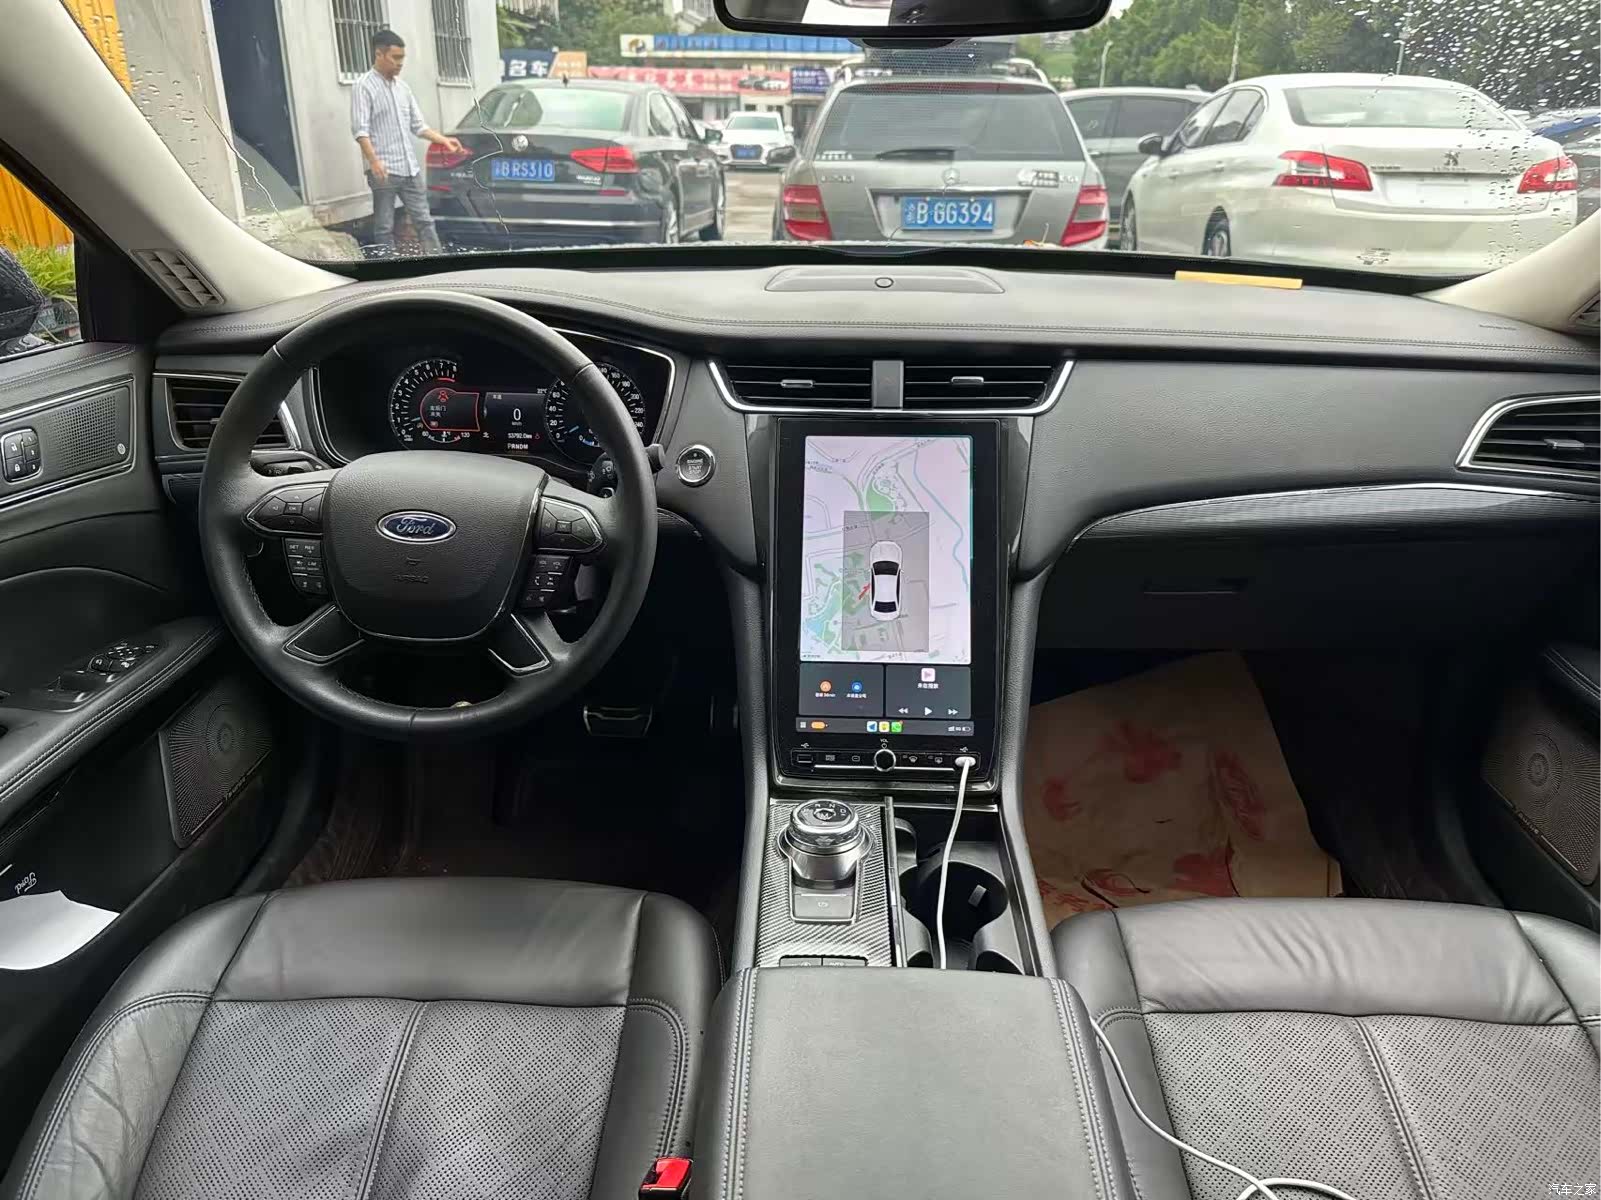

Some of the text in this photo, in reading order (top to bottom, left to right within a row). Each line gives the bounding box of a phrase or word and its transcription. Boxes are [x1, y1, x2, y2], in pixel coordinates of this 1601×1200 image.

[513, 408, 521, 421] 0
[396, 516, 438, 535] Ford
[14, 871, 37, 895] Ford
